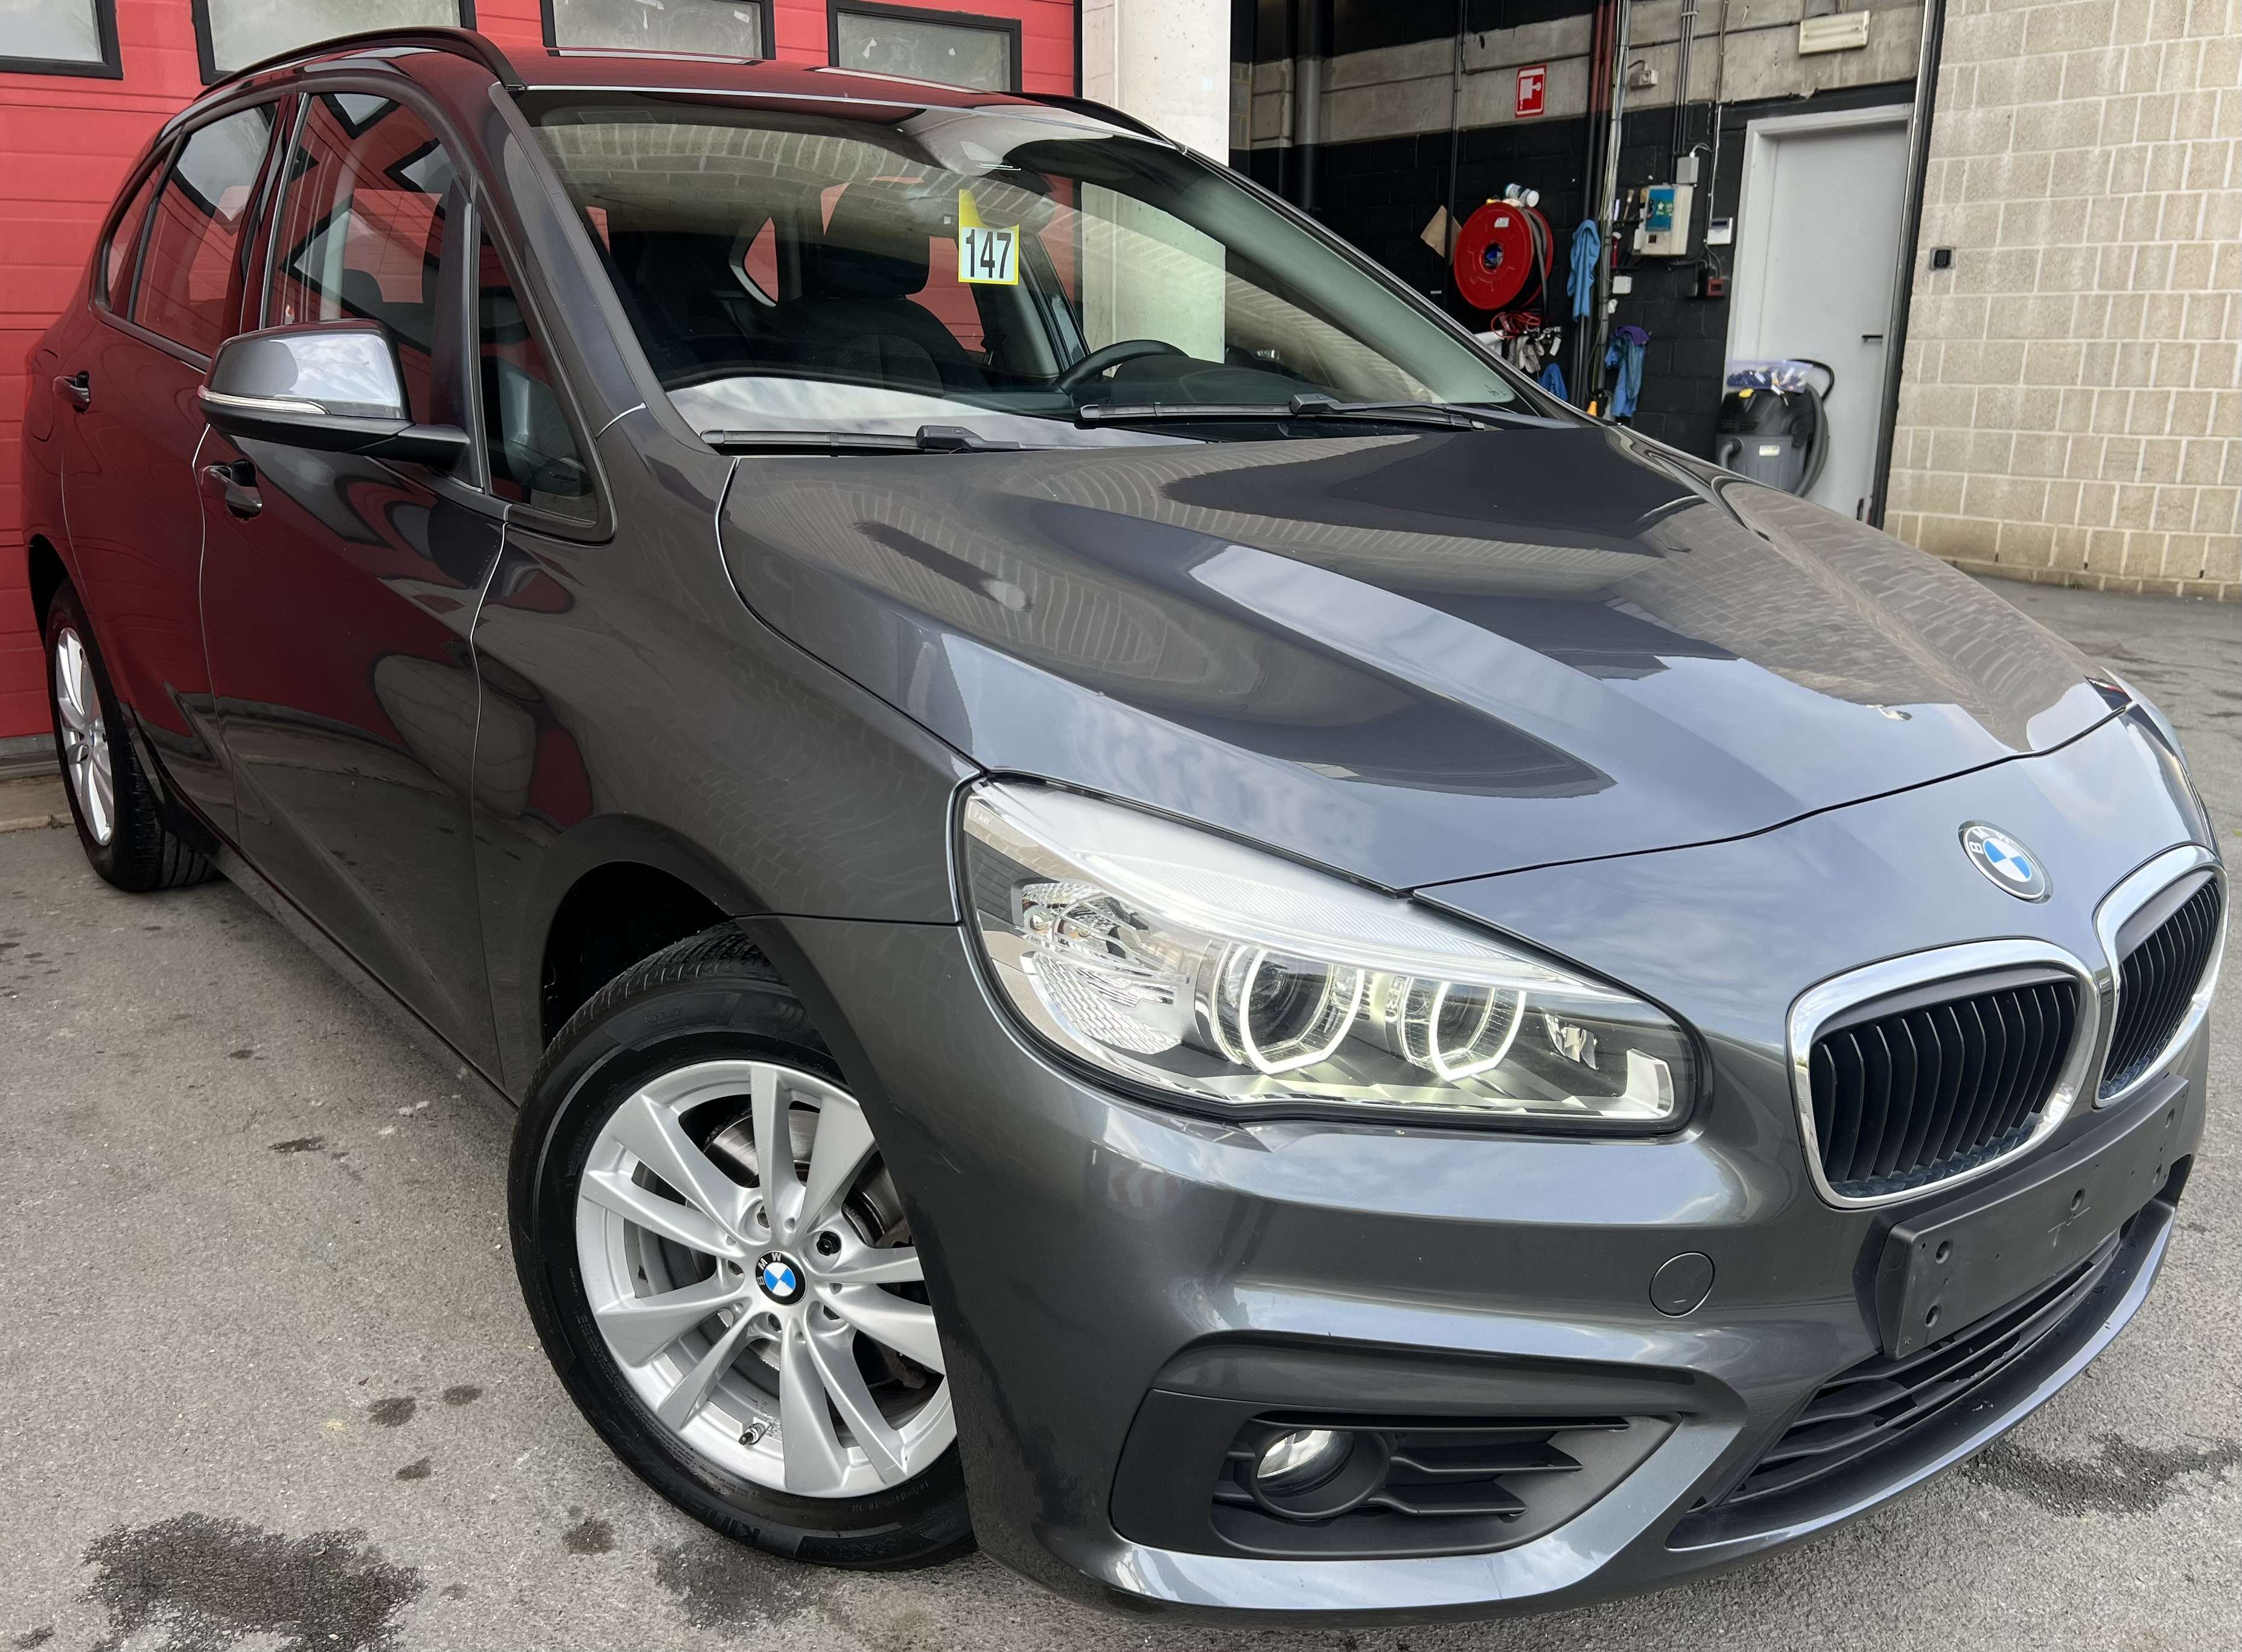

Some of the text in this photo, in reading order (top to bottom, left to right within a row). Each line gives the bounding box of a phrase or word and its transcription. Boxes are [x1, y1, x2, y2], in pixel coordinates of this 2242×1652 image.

[966, 229, 1011, 278] 147
[1969, 828, 2011, 855] BMW
[756, 1252, 782, 1286] BMW
